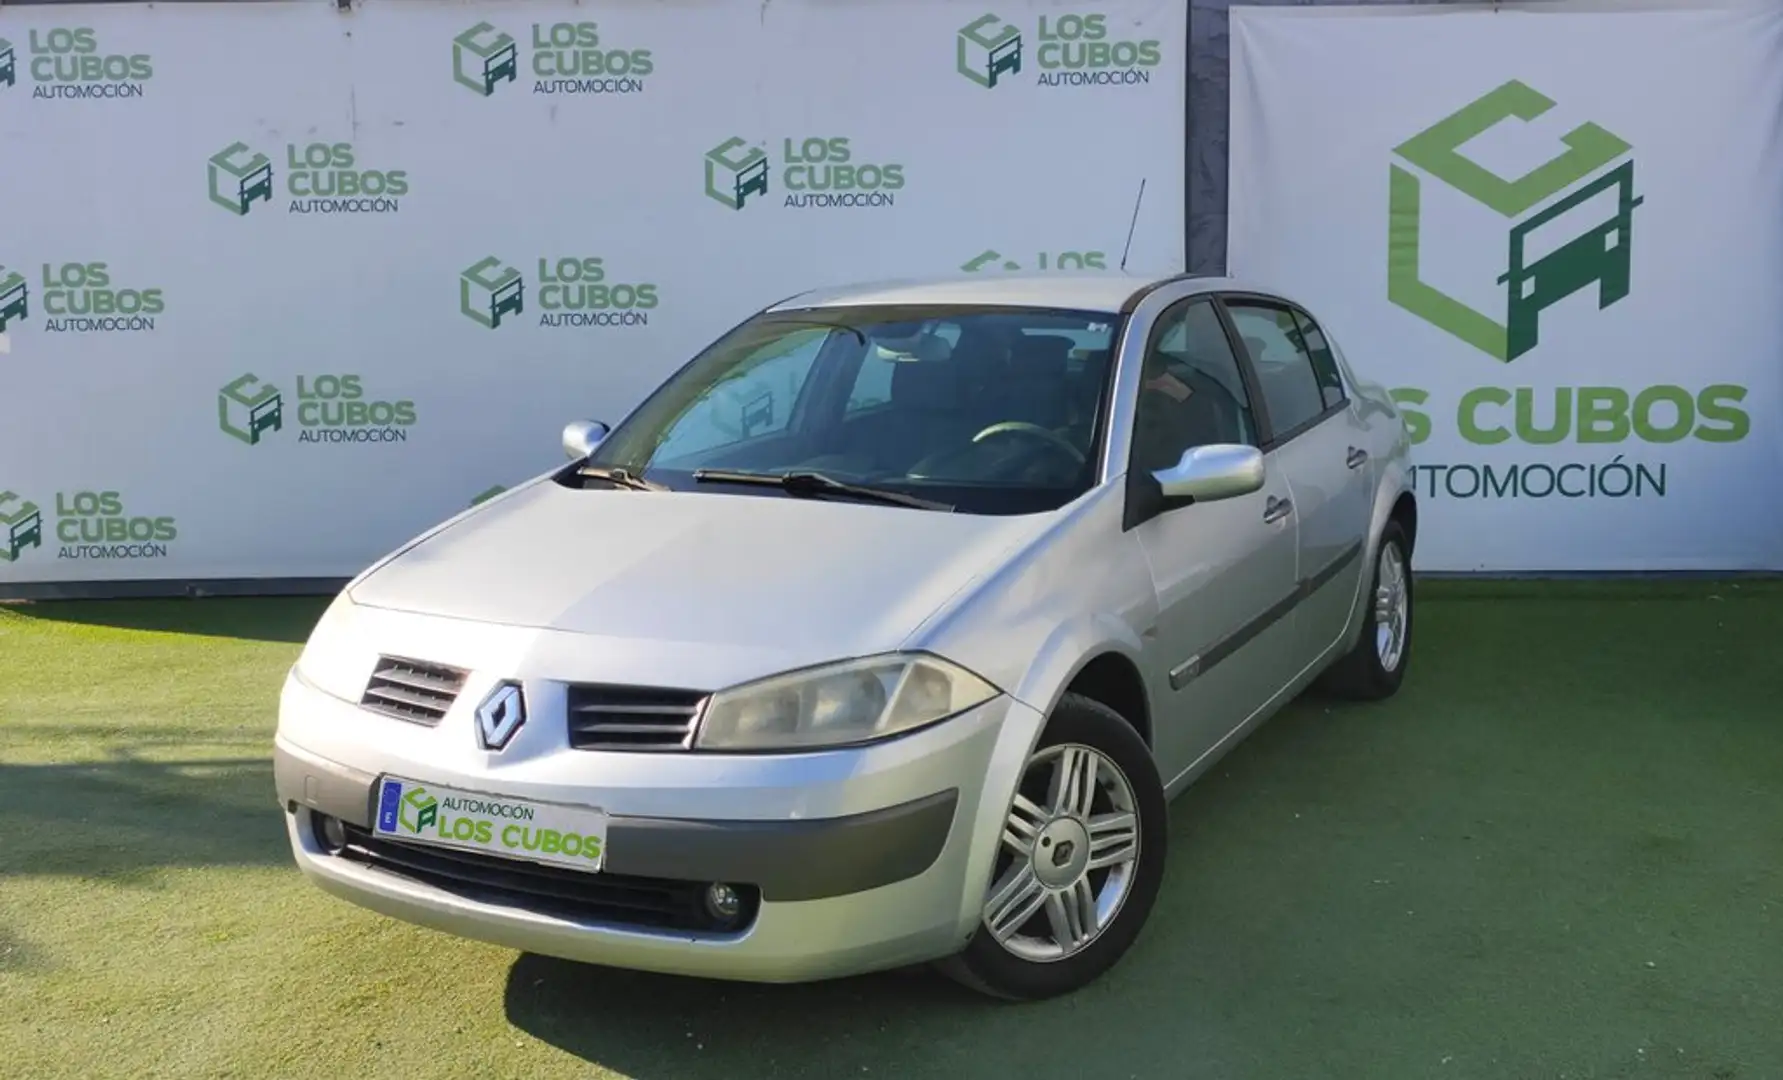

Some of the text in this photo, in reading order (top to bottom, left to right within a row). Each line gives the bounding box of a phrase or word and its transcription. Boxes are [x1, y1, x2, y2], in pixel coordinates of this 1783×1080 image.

[30, 28, 97, 54] LOS
[532, 22, 599, 49] LOS
[1038, 14, 1107, 41] LOS
[532, 49, 653, 76] CUBOS
[1037, 40, 1161, 68] CUBOS
[30, 54, 153, 82] CUBOS
[1038, 68, 1150, 86] AUTOMOCIÓN
[32, 82, 143, 99] AUTOMOCIÓN
[533, 77, 643, 94] AUTOMOCIÓN
[287, 143, 355, 170] LOS
[784, 138, 851, 164] LOS
[287, 170, 409, 197] CUBOS
[783, 164, 905, 192] CUBOS
[288, 196, 399, 213] AUTOMOCIÓN
[784, 191, 894, 208] AUTOMOCIÓN
[43, 262, 110, 289] LOS
[538, 257, 605, 284] LOS
[43, 288, 165, 315] CUBOS
[538, 283, 659, 310] CUBOS
[45, 315, 155, 332] AUTOMOCIÓN
[539, 310, 648, 327] AUTOMOCIÓN
[296, 375, 363, 401] LOS
[297, 401, 417, 428] CUBOS
[1457, 384, 1751, 446] CUBOS
[298, 426, 407, 443] AUTOMOCIÓN
[1410, 455, 1667, 498] TOMOCIÓN
[56, 491, 123, 517] LOS
[56, 517, 178, 544] CUBOS
[58, 542, 167, 559] AUTOMOCIÓN
[442, 797, 534, 821] AUTOMOCIÓN
[438, 815, 602, 860] LOS CUBOS
